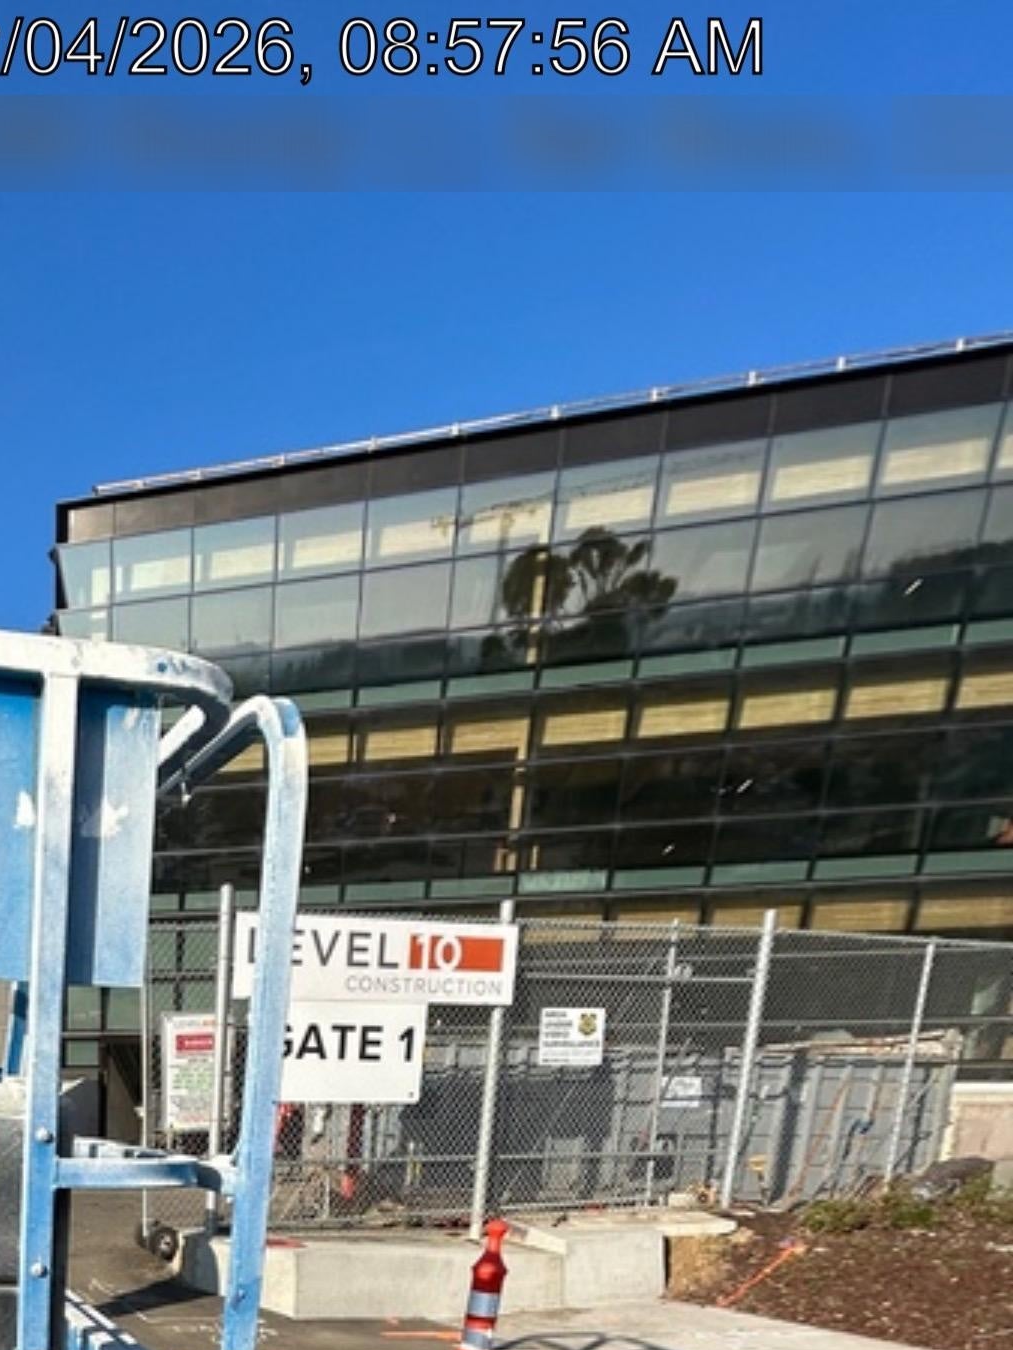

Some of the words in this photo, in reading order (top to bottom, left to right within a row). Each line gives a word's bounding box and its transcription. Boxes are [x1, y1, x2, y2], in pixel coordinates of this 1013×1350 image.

[413, 933, 463, 972] 10
[345, 974, 503, 996] CONSTRUCTION
[399, 1026, 415, 1063] 1
